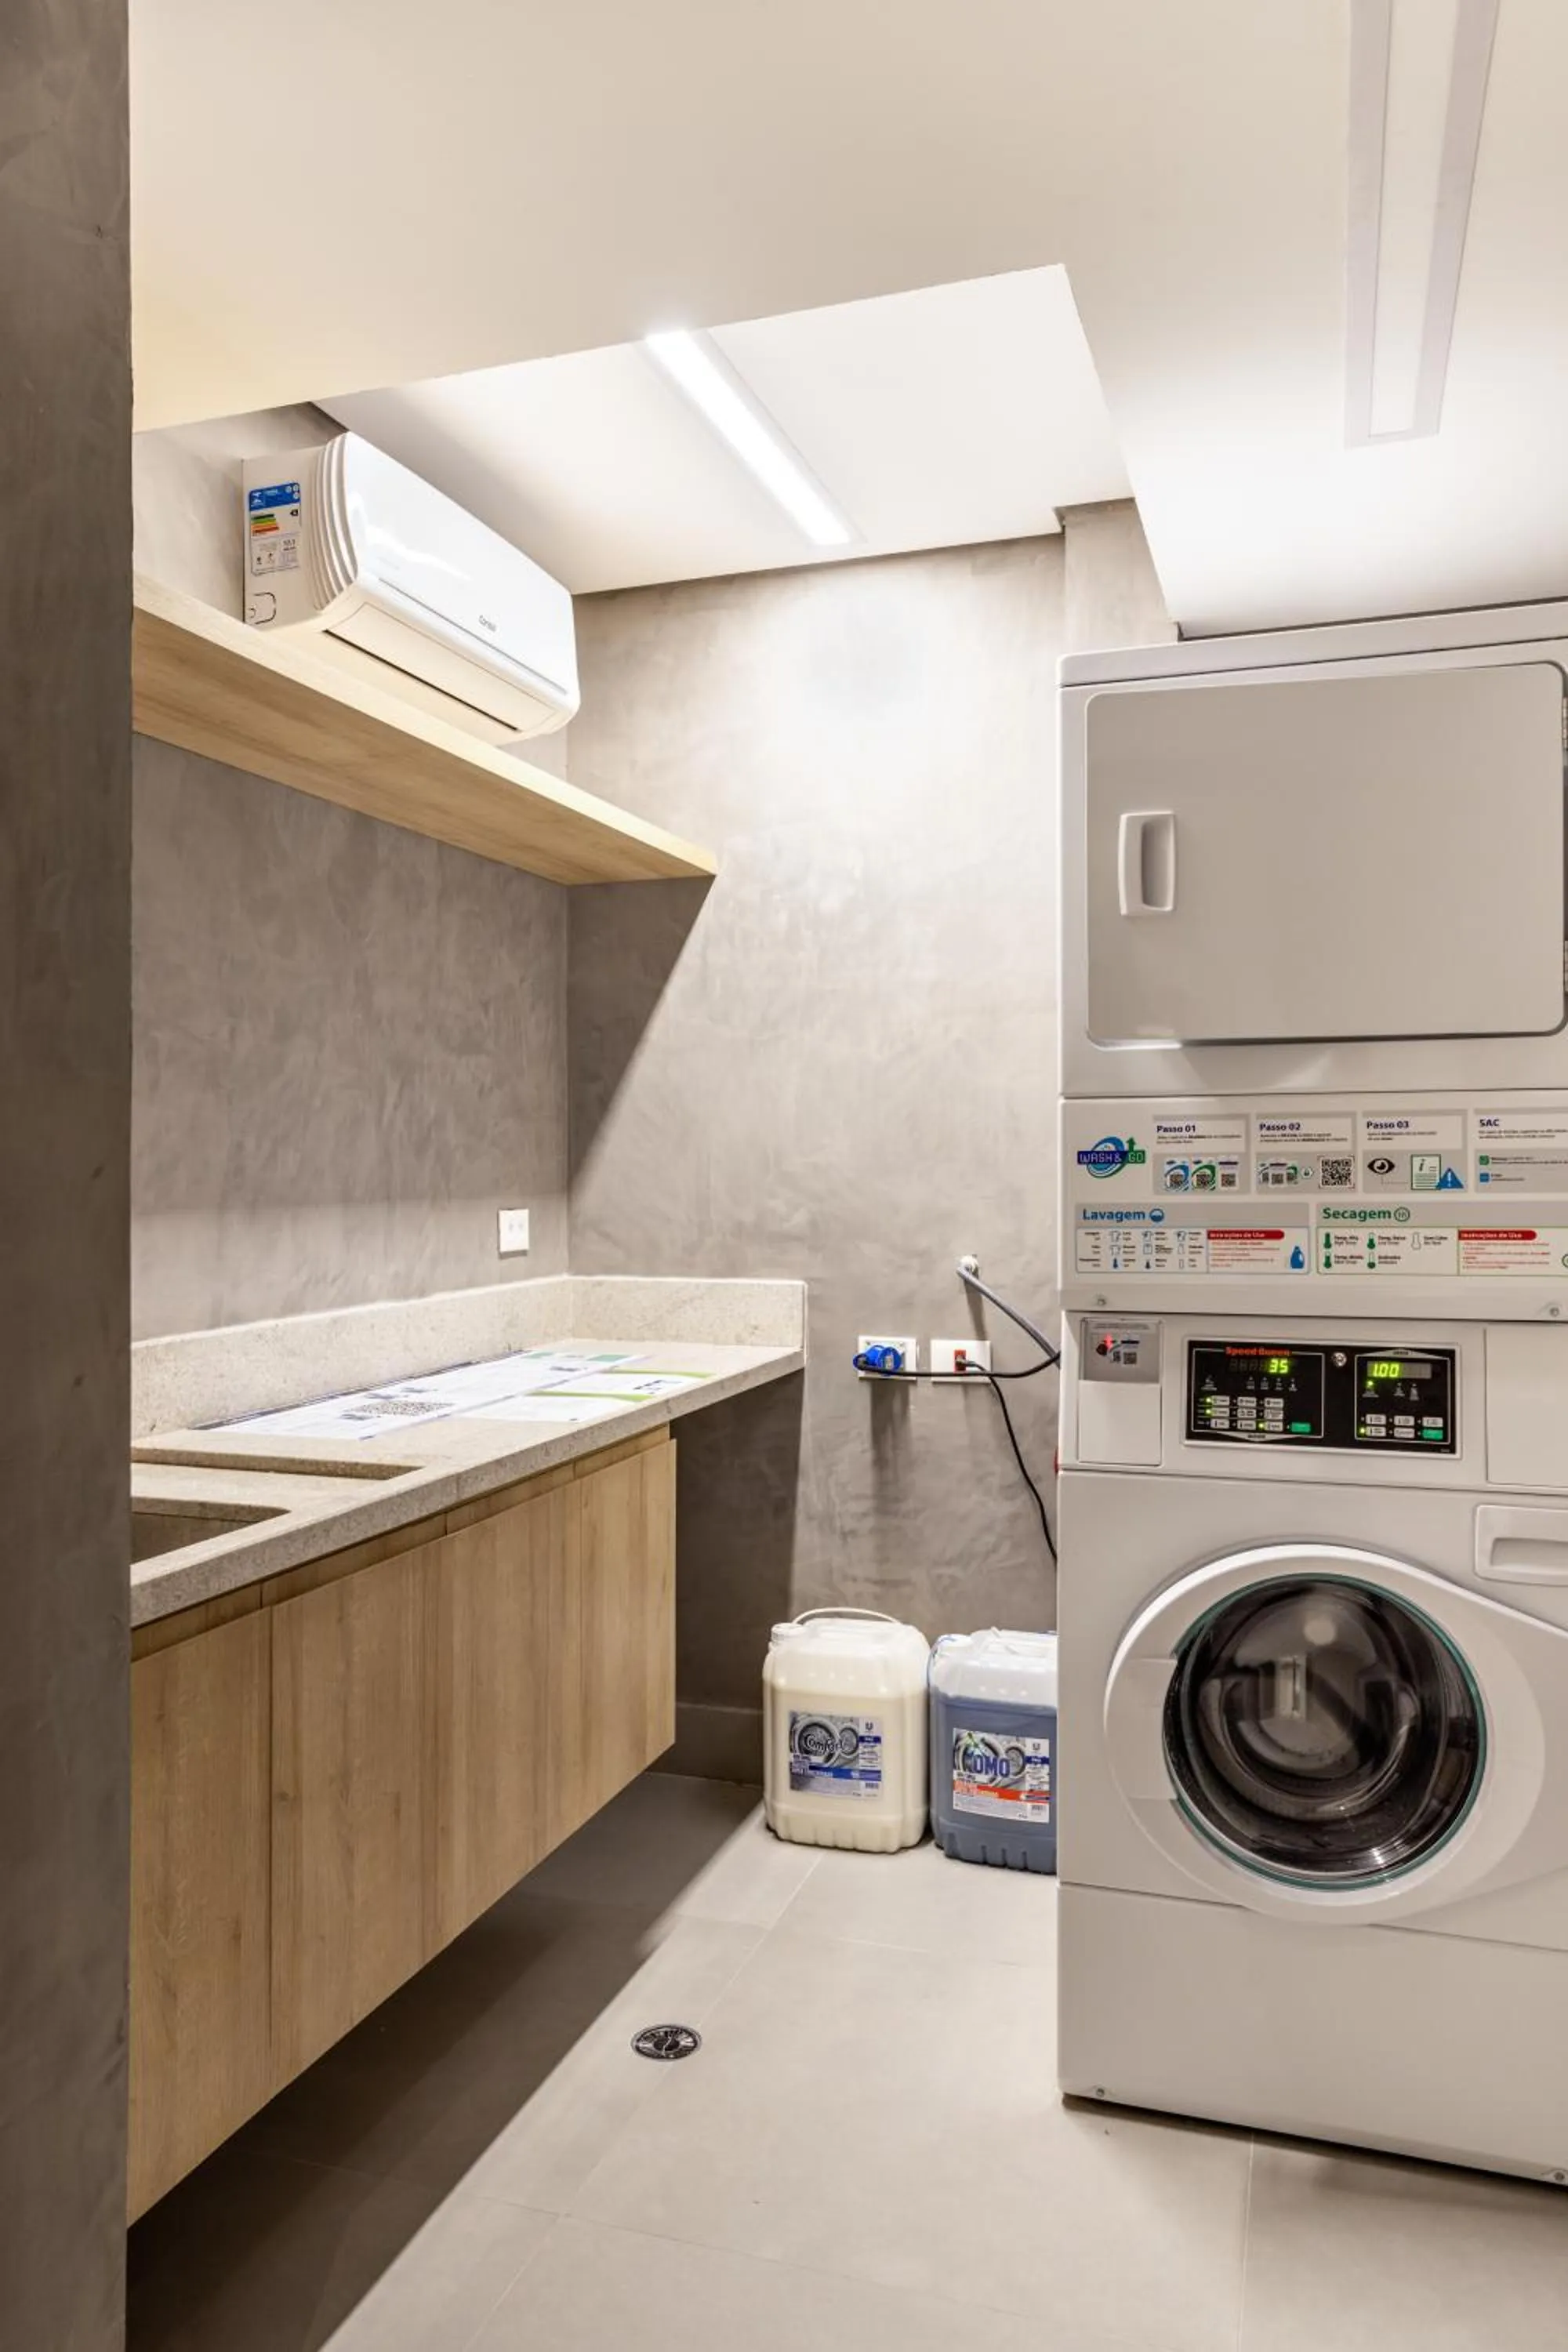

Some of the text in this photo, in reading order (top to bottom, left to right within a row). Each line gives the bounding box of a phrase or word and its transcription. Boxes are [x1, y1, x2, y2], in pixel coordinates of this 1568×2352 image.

[1080, 1152, 1112, 1163] WASH
[1129, 1152, 1143, 1163] GO
[1083, 1208, 1145, 1222] Lavagem
[1323, 1207, 1392, 1222] Secagem
[1225, 1346, 1256, 1356] Speed
[1269, 1358, 1289, 1374] 35
[804, 1733, 843, 1754] Comfort
[972, 1755, 1011, 1778] OMO
